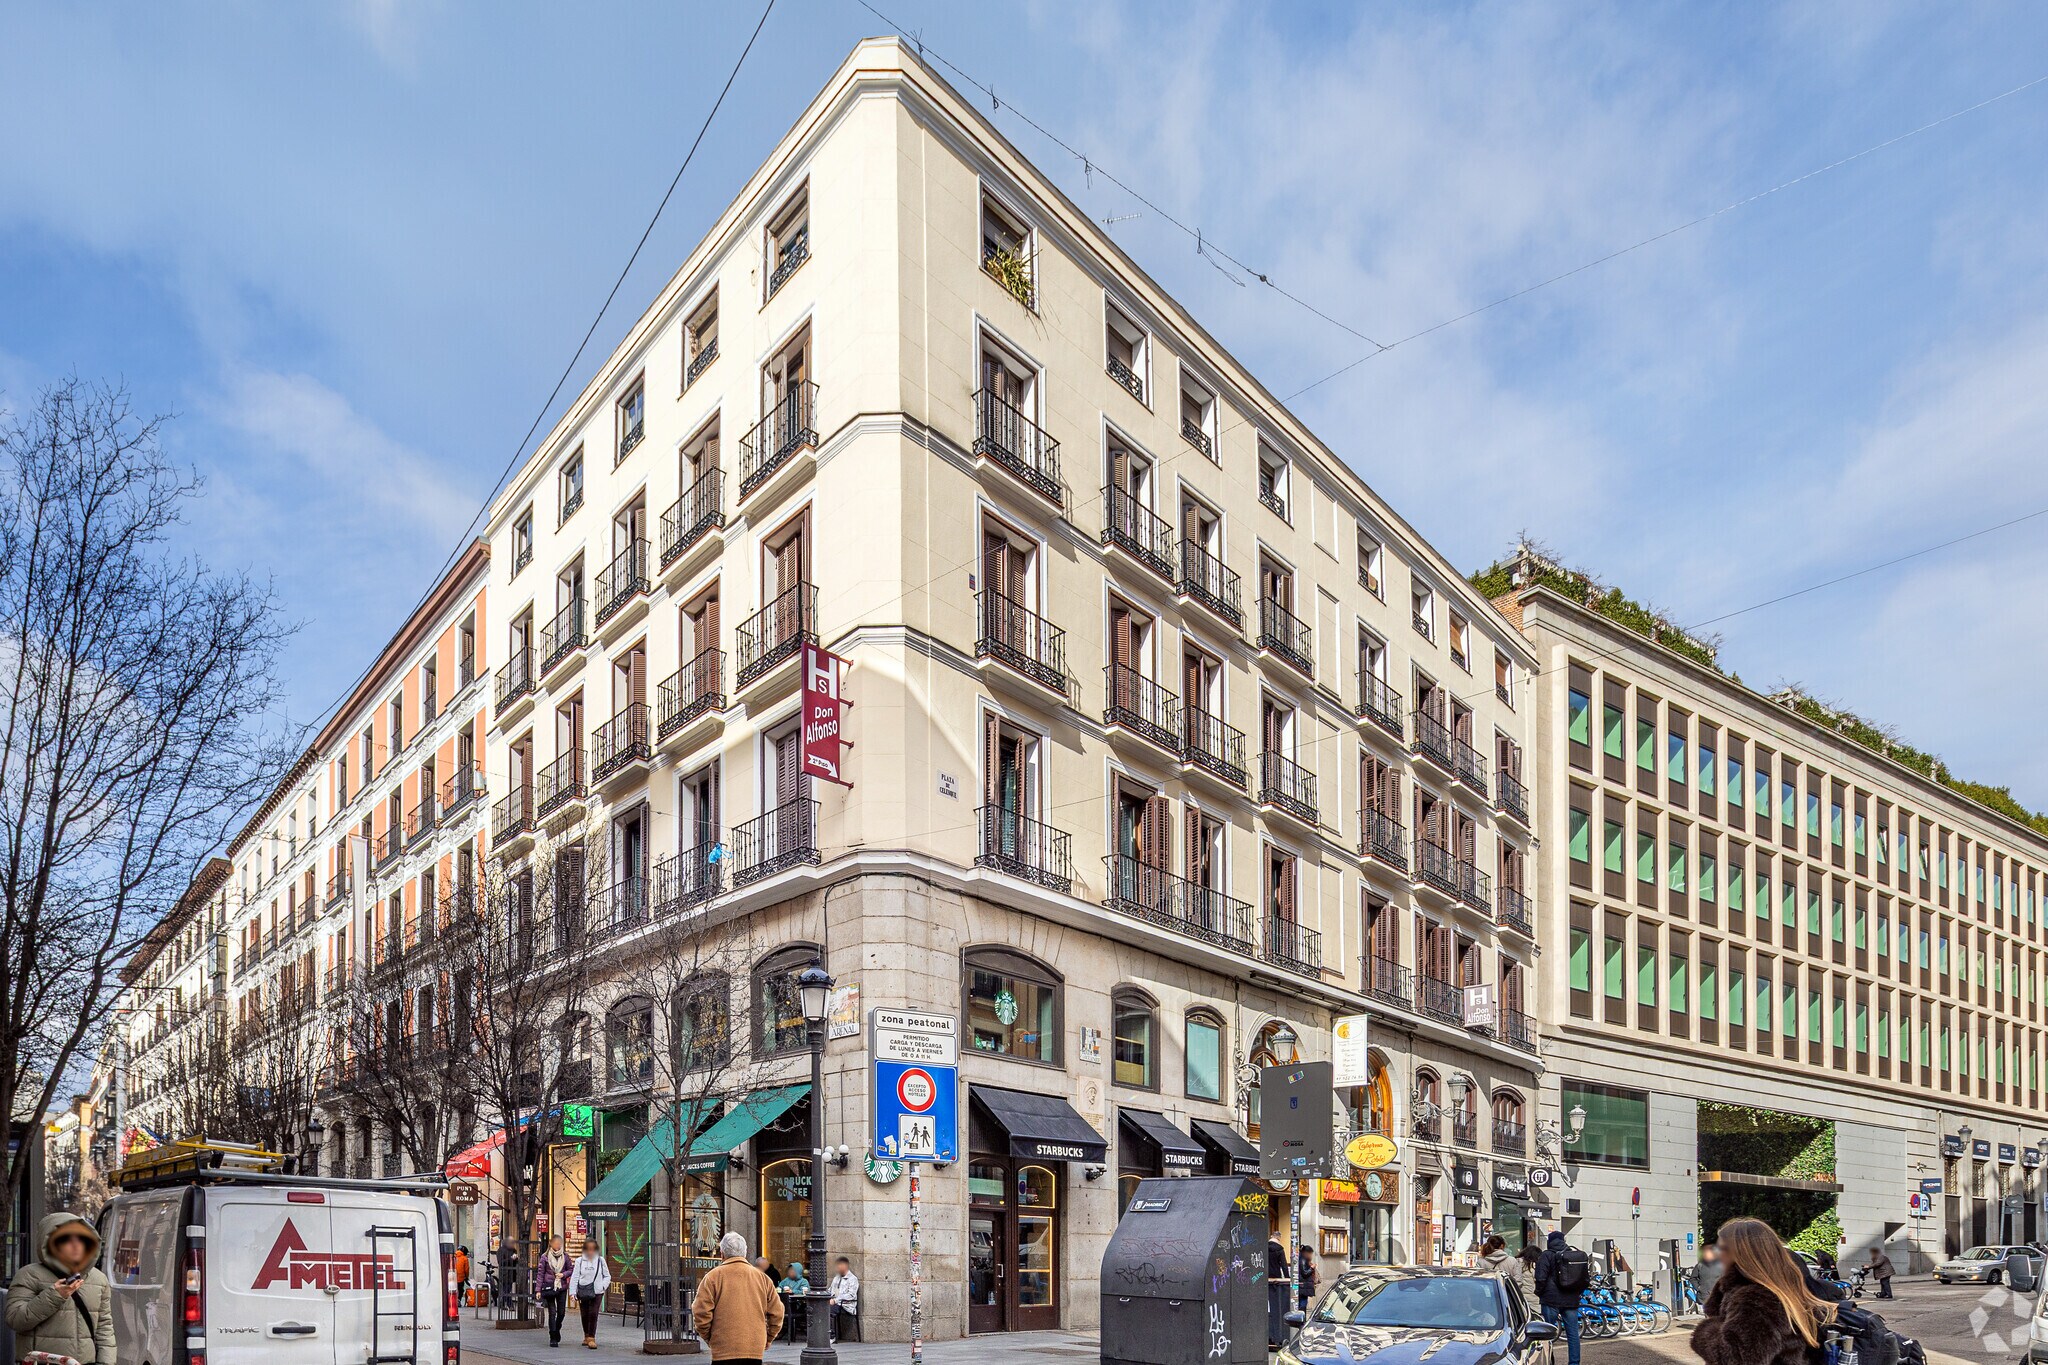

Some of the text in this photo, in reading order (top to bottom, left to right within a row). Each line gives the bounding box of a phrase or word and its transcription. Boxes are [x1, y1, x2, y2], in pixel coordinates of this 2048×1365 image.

[808, 648, 837, 700] H
[814, 706, 833, 719] Don
[806, 719, 838, 745] Alfonso
[941, 773, 955, 785] PLAZA
[1469, 987, 1488, 1006] H
[1475, 1007, 1489, 1015] Don
[881, 1015, 950, 1029] zona peatonal
[1467, 1013, 1491, 1024] Alfonso
[831, 1024, 857, 1037] ARENAL
[902, 1034, 930, 1042] PERMITIDO
[914, 1041, 943, 1049] DESCARGA
[1036, 1144, 1084, 1158] STARBUCKS
[1165, 1153, 1203, 1166] STARBUCKS
[1234, 1163, 1260, 1174] STARBUC
[768, 1175, 813, 1187] STARBUCK
[393, 1324, 433, 1332] RENULT
